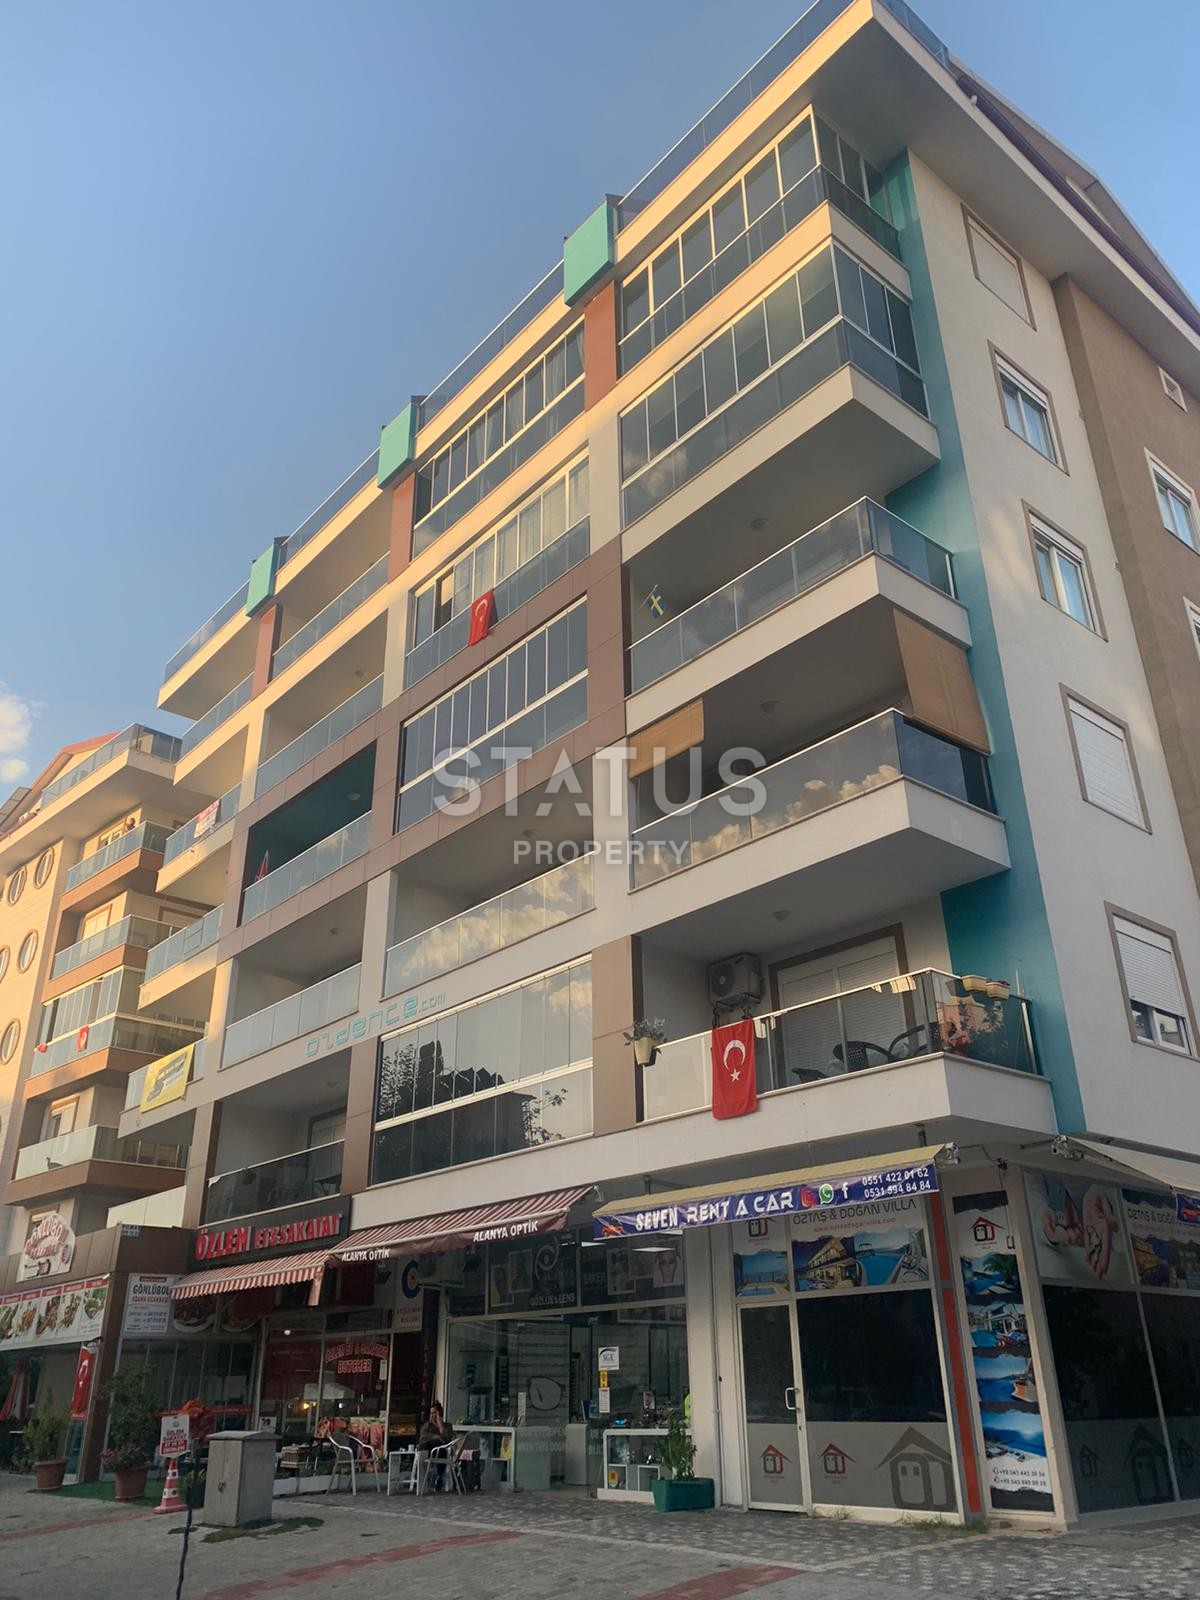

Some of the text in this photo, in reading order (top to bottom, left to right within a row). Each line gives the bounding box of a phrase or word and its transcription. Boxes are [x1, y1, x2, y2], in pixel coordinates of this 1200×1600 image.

[862, 1174, 883, 1186] 0551
[885, 1171, 902, 1183] 422
[905, 1181, 918, 1192] 84
[919, 1179, 931, 1191] 84
[635, 1191, 795, 1232] SEVEN RENT A CAR
[829, 1207, 838, 1221] &
[840, 1204, 881, 1219] DOĞAN
[882, 1198, 917, 1213] VILLA
[473, 1225, 508, 1243] ALANYA
[509, 1219, 539, 1239] OPTİK
[341, 1249, 368, 1263] ALANYA
[337, 1359, 372, 1374] BUTCHER
